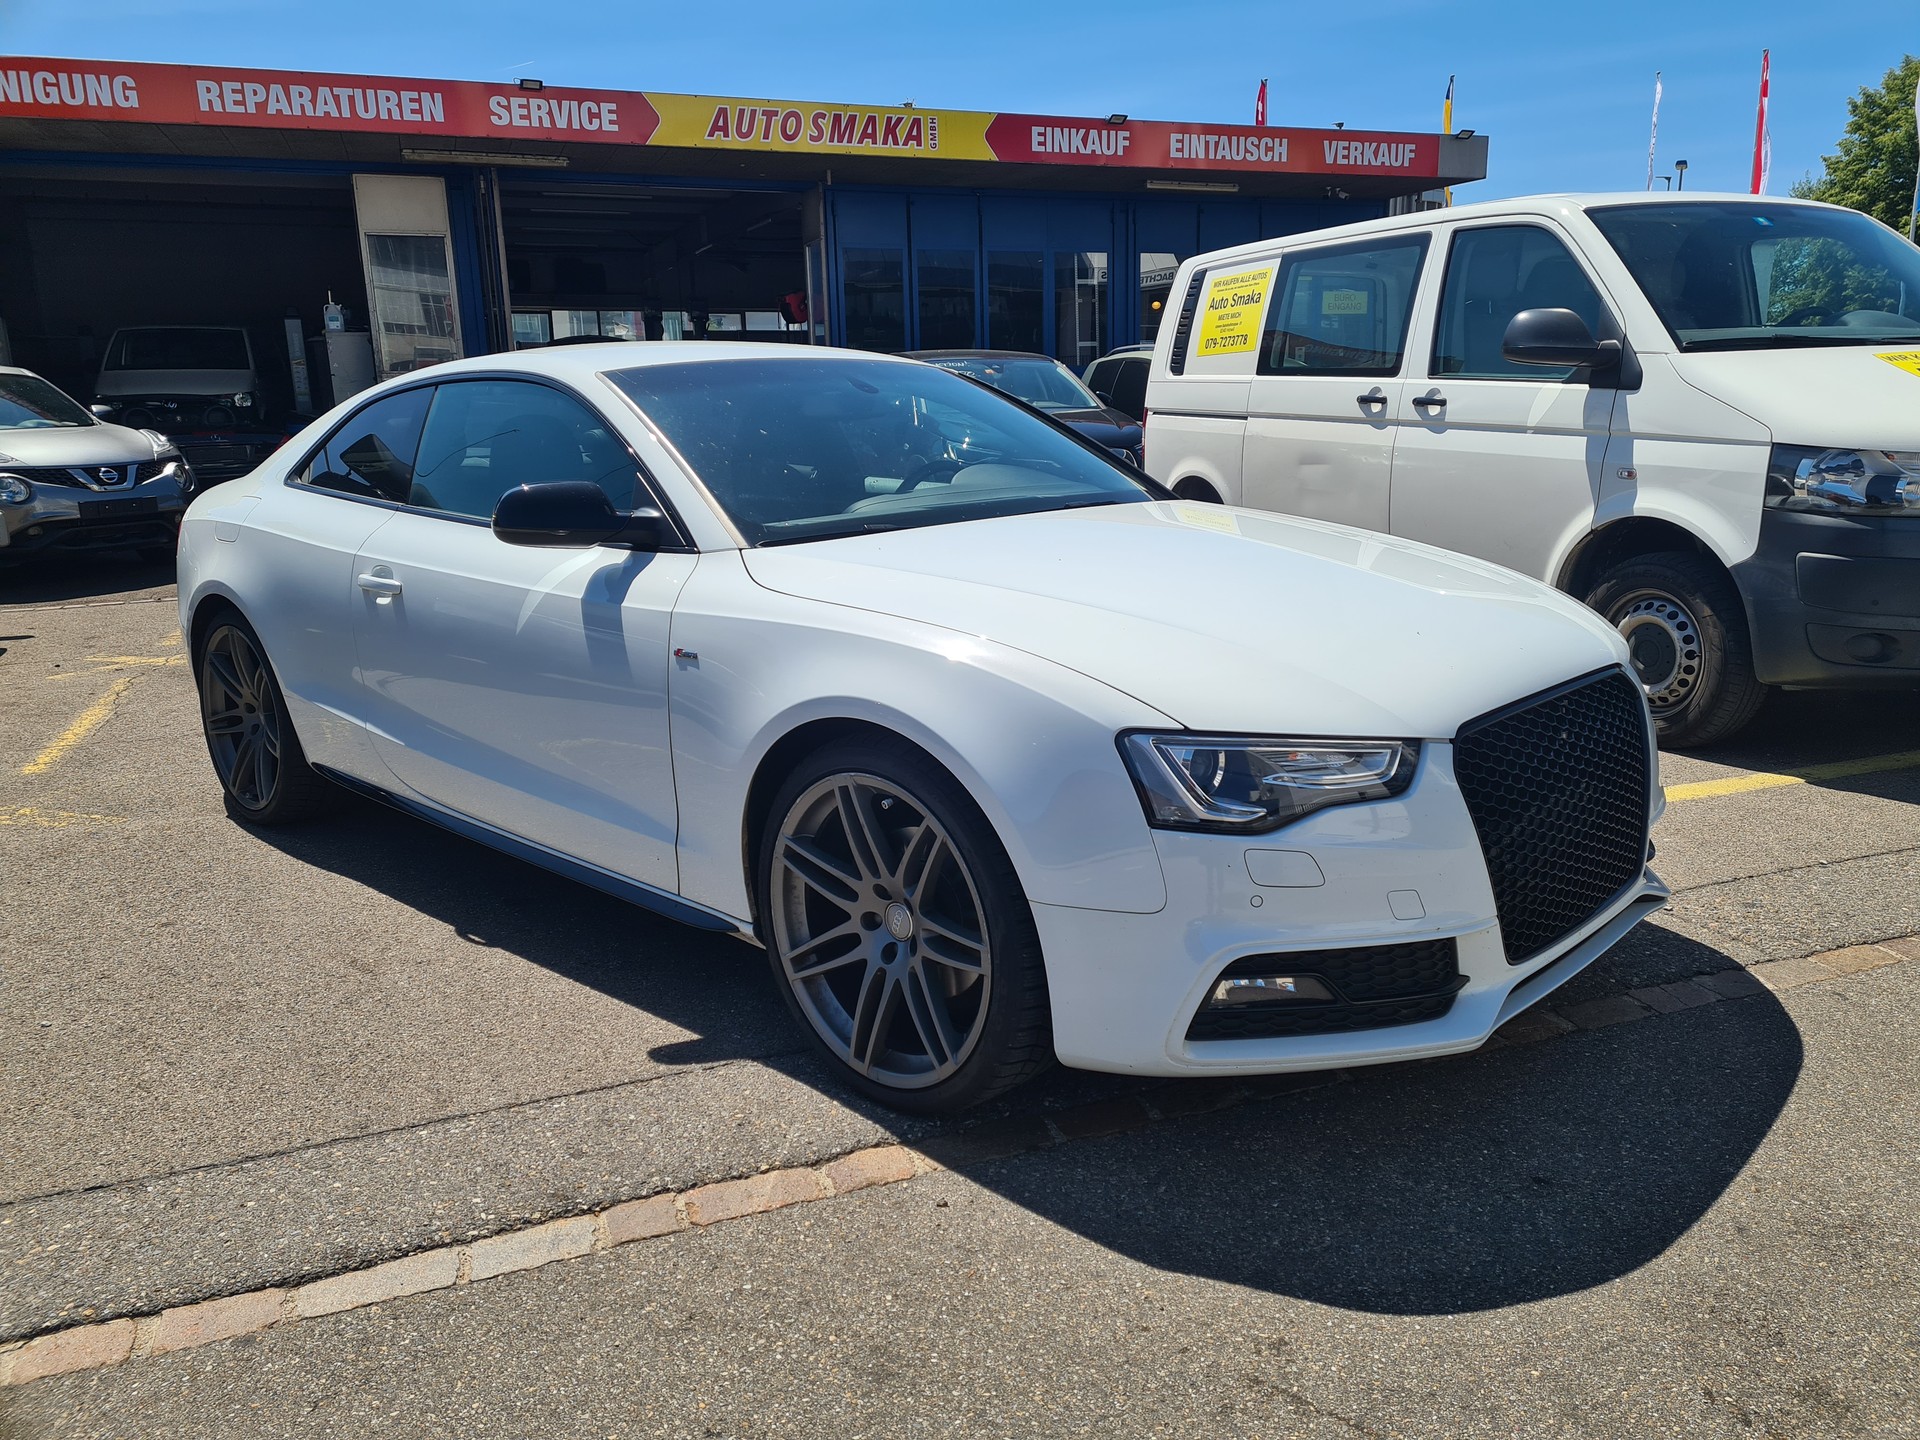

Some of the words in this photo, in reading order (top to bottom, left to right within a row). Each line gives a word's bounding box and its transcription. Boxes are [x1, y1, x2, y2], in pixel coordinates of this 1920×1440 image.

[0, 70, 139, 108] NIGUNG
[196, 79, 445, 123] REPARATUREN
[489, 95, 619, 132] SERVICE
[705, 105, 804, 144] AUTO
[807, 110, 925, 149] SMAKA
[928, 116, 939, 150] GMBH
[1031, 125, 1130, 156] EINKAUF
[1169, 132, 1289, 163] EINTAUSCH
[1323, 139, 1416, 167] VERKAUF
[1214, 279, 1223, 288] WIR
[1222, 277, 1241, 286] KAUFEN
[1240, 275, 1252, 283] ALLE
[1251, 271, 1268, 281] AUTOS
[1208, 296, 1229, 311] Auto
[1230, 289, 1262, 307] Smaka
[1327, 302, 1362, 311] EINGANG
[1217, 313, 1230, 321] MIETE
[1230, 311, 1242, 320] MICH
[1205, 334, 1248, 349] 079-7273778
